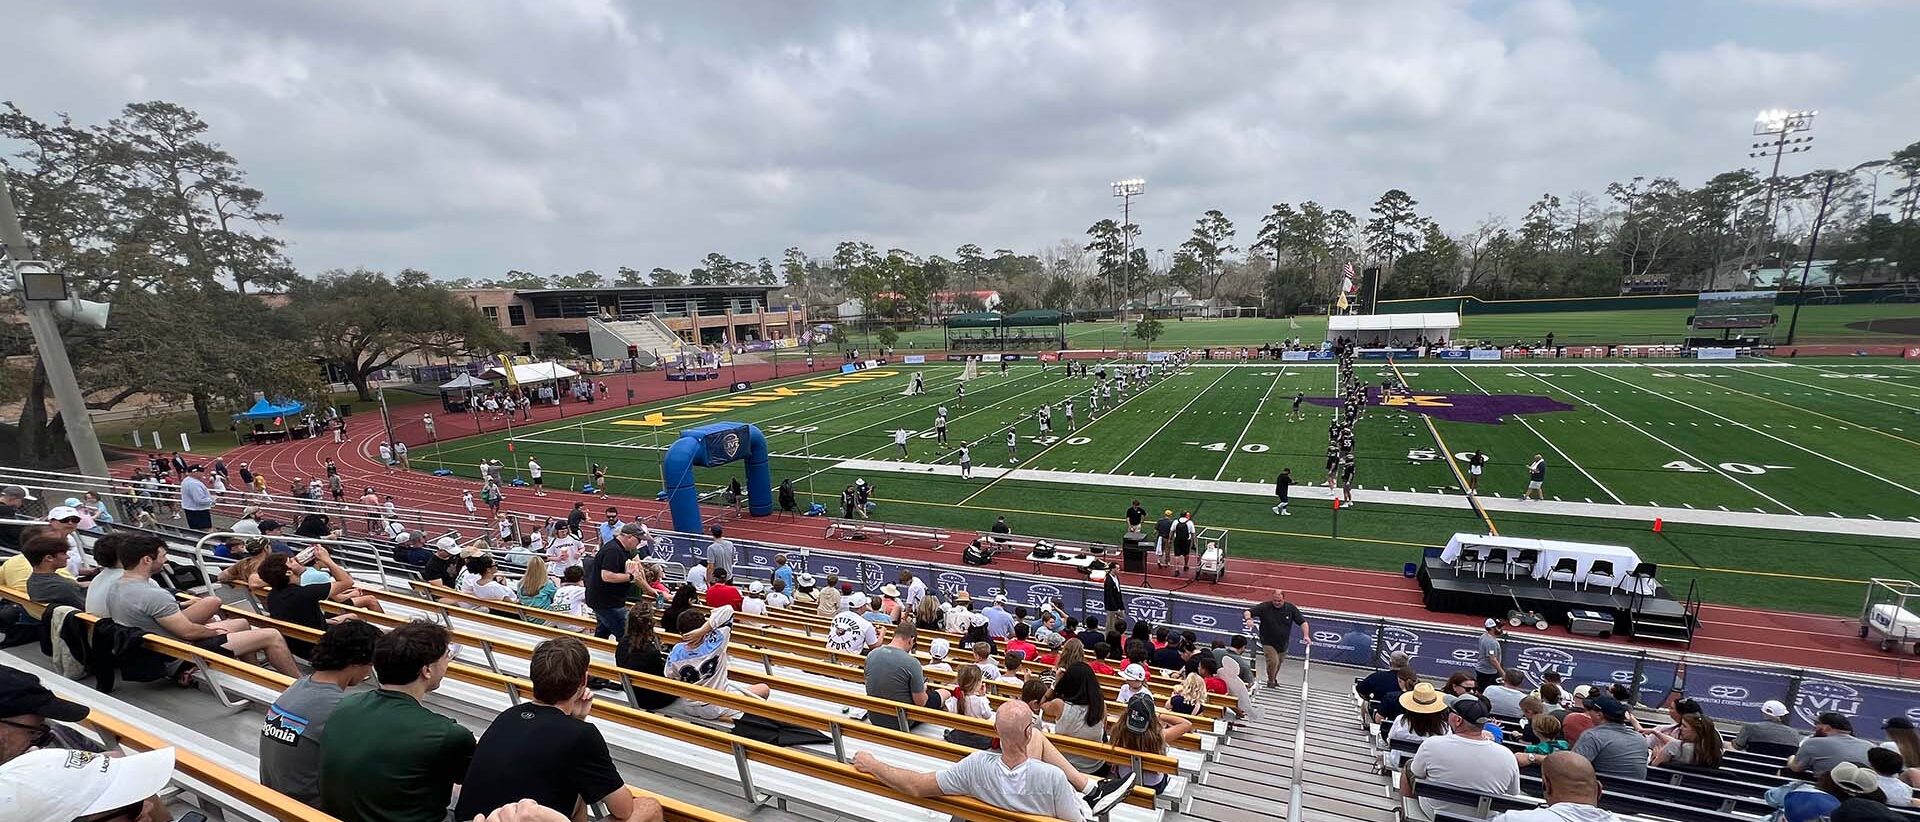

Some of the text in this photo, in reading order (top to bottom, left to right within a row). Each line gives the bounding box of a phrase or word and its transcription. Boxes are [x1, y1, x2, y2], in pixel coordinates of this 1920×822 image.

[1201, 441, 1270, 453] 40
[1662, 460, 1767, 475] 40
[263, 722, 296, 743] gonia
